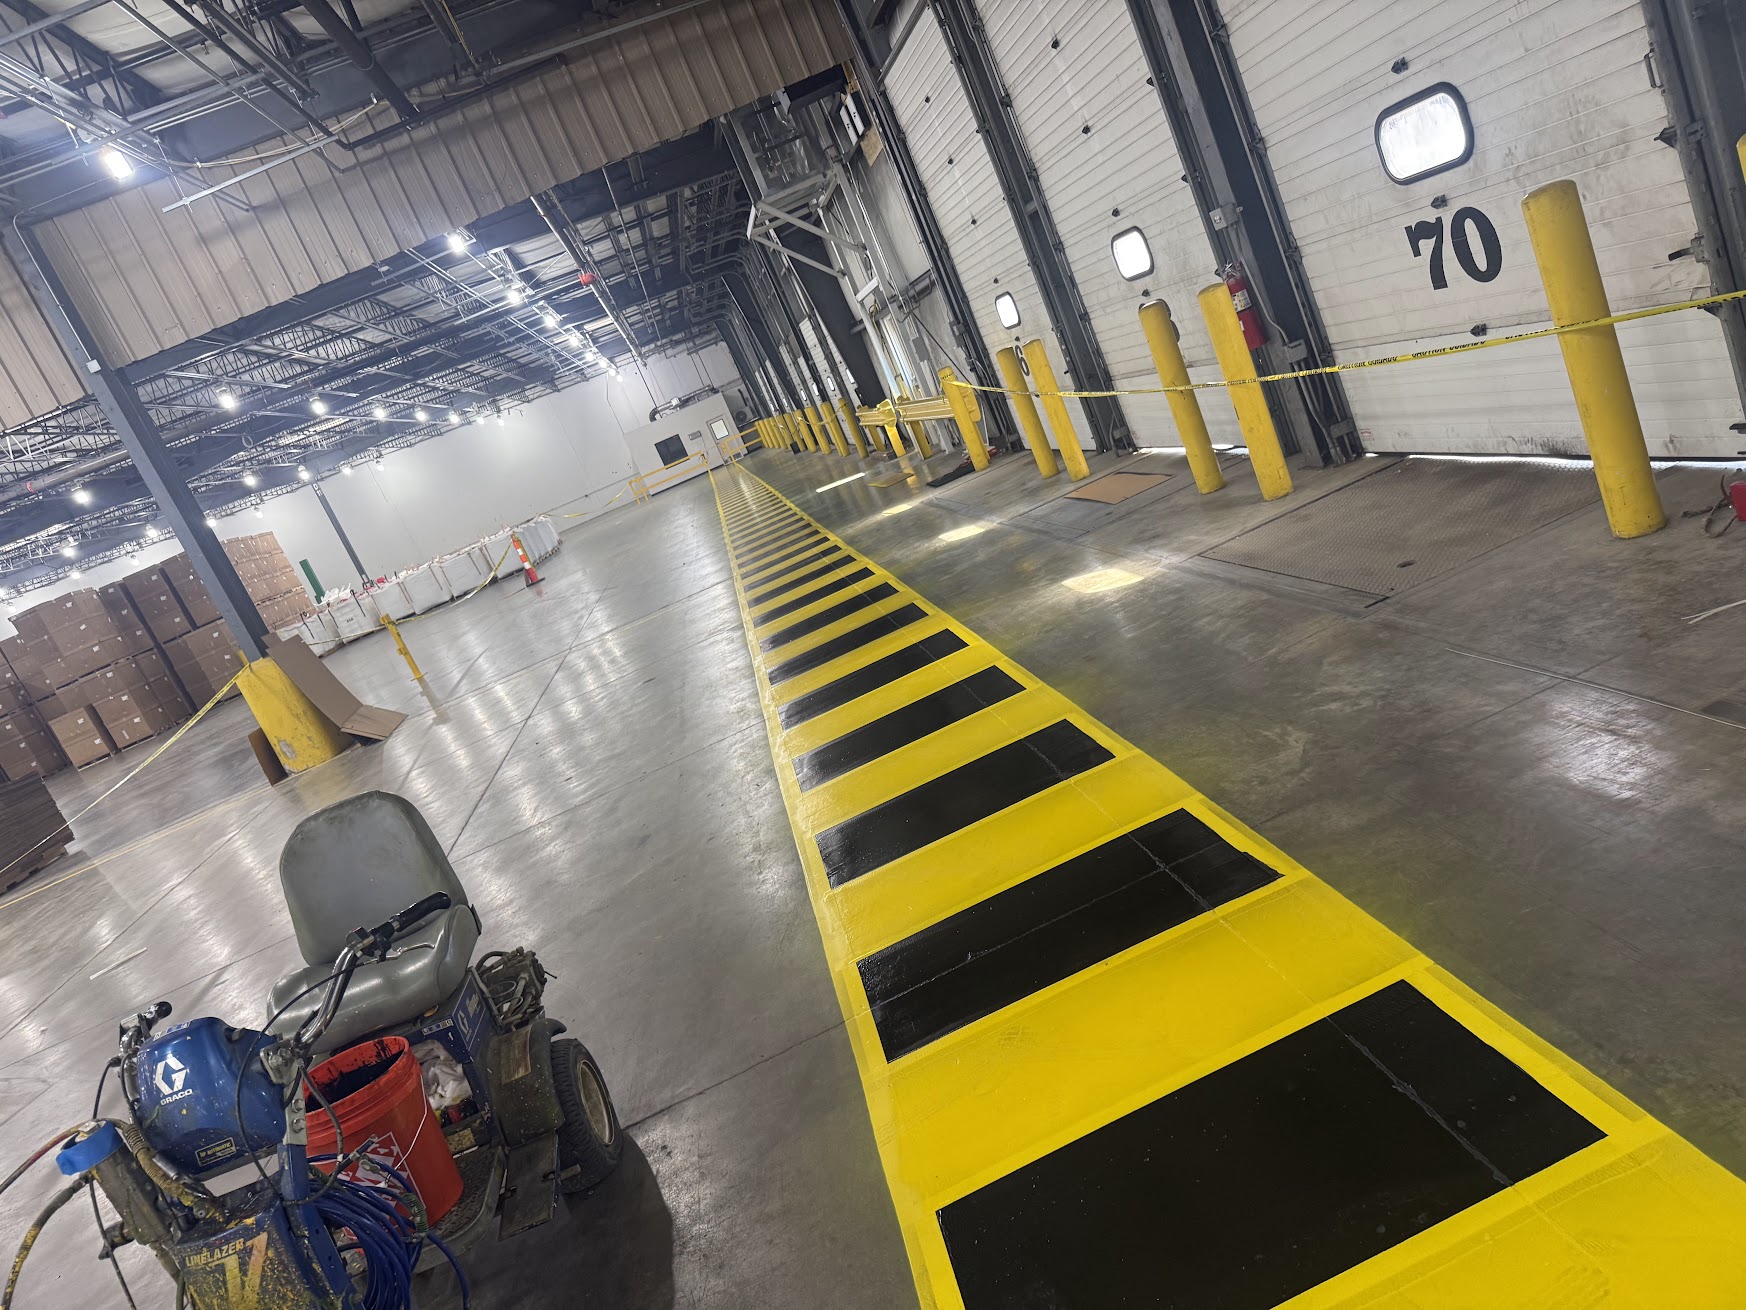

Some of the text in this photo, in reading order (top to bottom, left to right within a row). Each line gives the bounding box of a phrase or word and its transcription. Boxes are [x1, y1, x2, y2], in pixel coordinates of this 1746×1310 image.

[1404, 206, 1503, 291] 70
[160, 1088, 193, 1106] GRACO
[185, 1238, 244, 1267] LINELAZER
